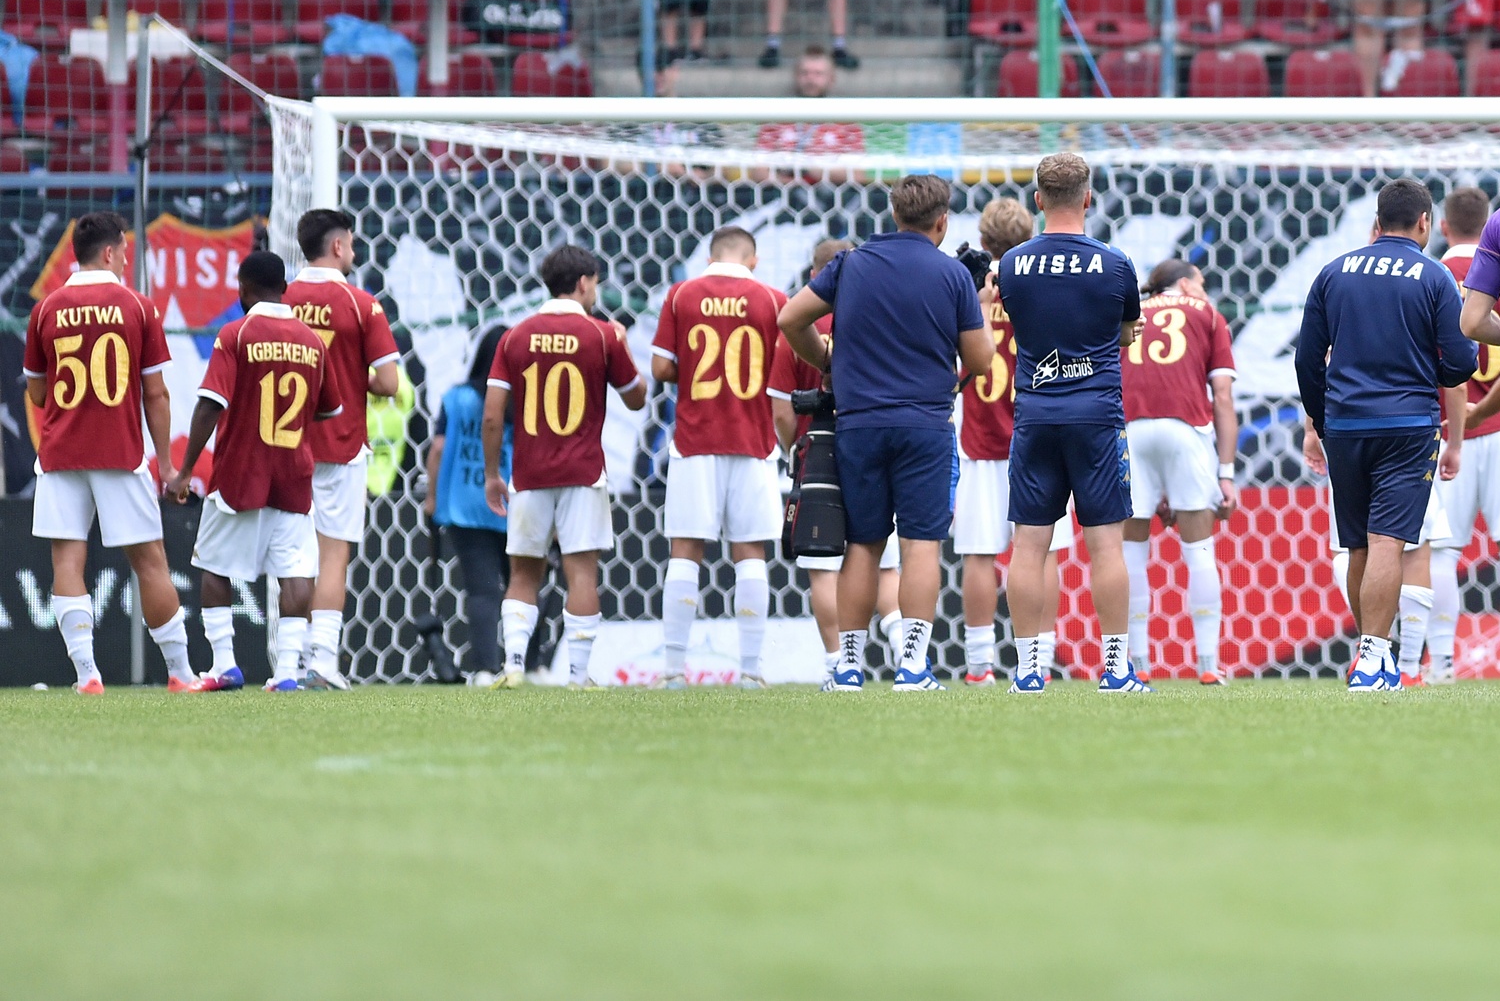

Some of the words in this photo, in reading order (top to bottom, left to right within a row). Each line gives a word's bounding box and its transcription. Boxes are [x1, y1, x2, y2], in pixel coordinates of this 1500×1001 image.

[1014, 253, 1104, 276] WISŁA
[1341, 255, 1425, 281] WISŁA
[55, 305, 125, 328] KUTWA
[292, 301, 333, 327] OŽIĆ
[700, 295, 749, 318] OMIĆ
[246, 341, 320, 370] IGBEKEME
[528, 333, 580, 355] FRED
[52, 331, 131, 411] 50
[687, 323, 765, 400] 20
[1061, 363, 1094, 379] SOCIOS
[259, 369, 309, 448] 12
[521, 360, 586, 437] 10
